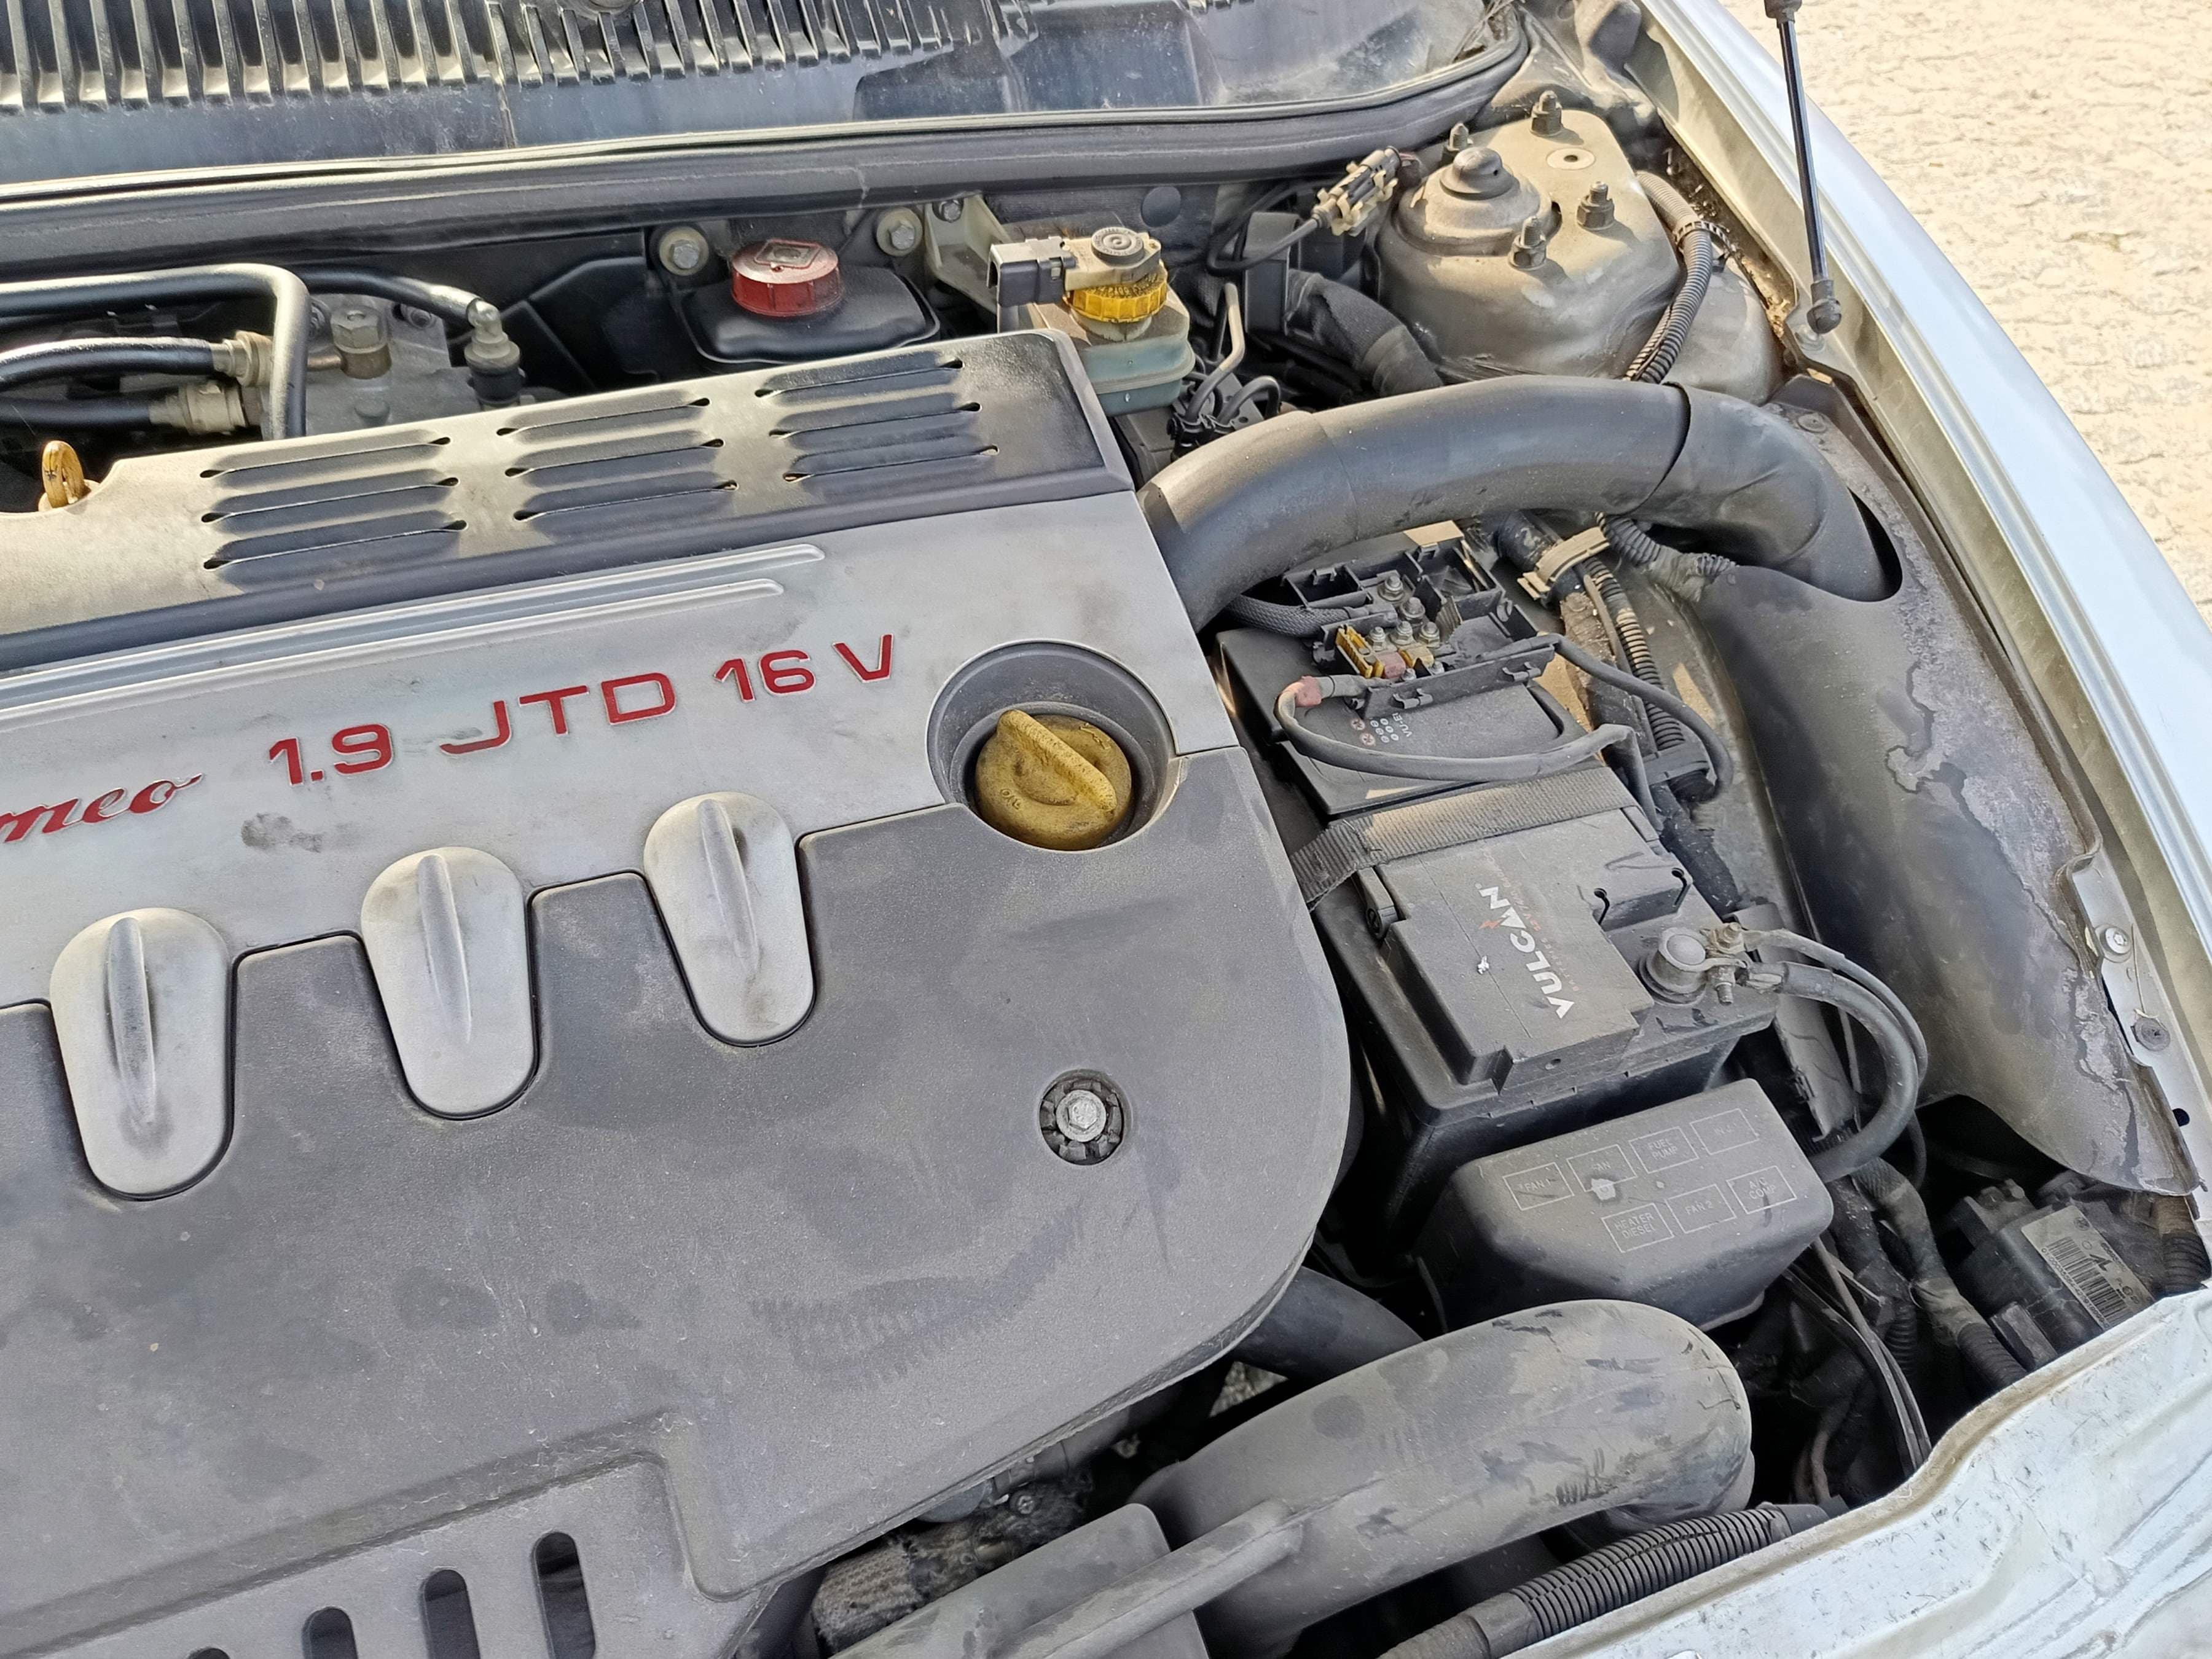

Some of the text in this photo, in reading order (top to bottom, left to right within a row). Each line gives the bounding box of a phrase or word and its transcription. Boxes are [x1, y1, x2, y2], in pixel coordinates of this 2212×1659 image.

[269, 723, 394, 786] 1.9
[438, 672, 677, 756] JTD
[1478, 886, 1575, 1019] VULCAN
[1647, 1137, 1674, 1151] FUEL
[1650, 1145, 1679, 1161] PUMP
[1524, 1179, 1545, 1192] FAN
[1749, 1176, 1768, 1190] A/C
[1748, 1184, 1778, 1200] COMP
[1685, 1199, 1714, 1216] FAN 2
[1614, 1212, 1655, 1231] HEATER
[1621, 1222, 1656, 1241] DIESEL
